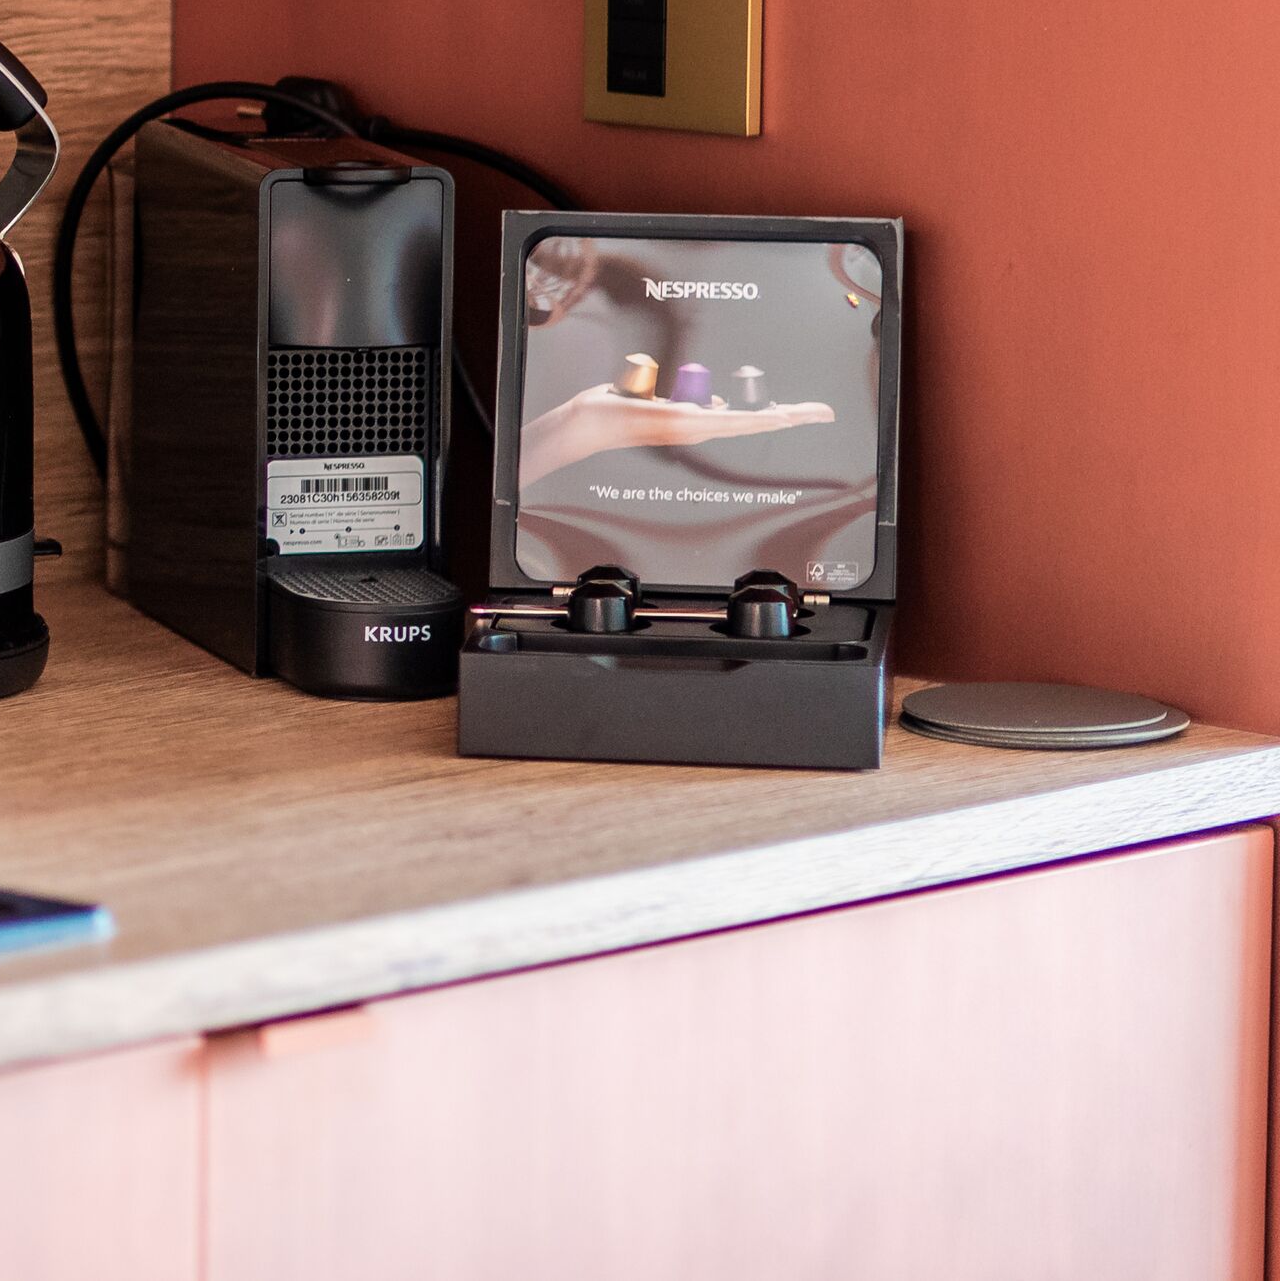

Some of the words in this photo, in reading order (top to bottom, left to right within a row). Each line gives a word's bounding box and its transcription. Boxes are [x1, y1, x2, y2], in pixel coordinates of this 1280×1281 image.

[642, 277, 759, 301] NESPRESSO
[622, 488, 646, 500] are
[648, 487, 673, 501] the
[676, 487, 730, 502] choices
[732, 491, 754, 503] we
[364, 624, 432, 643] KRUPS
